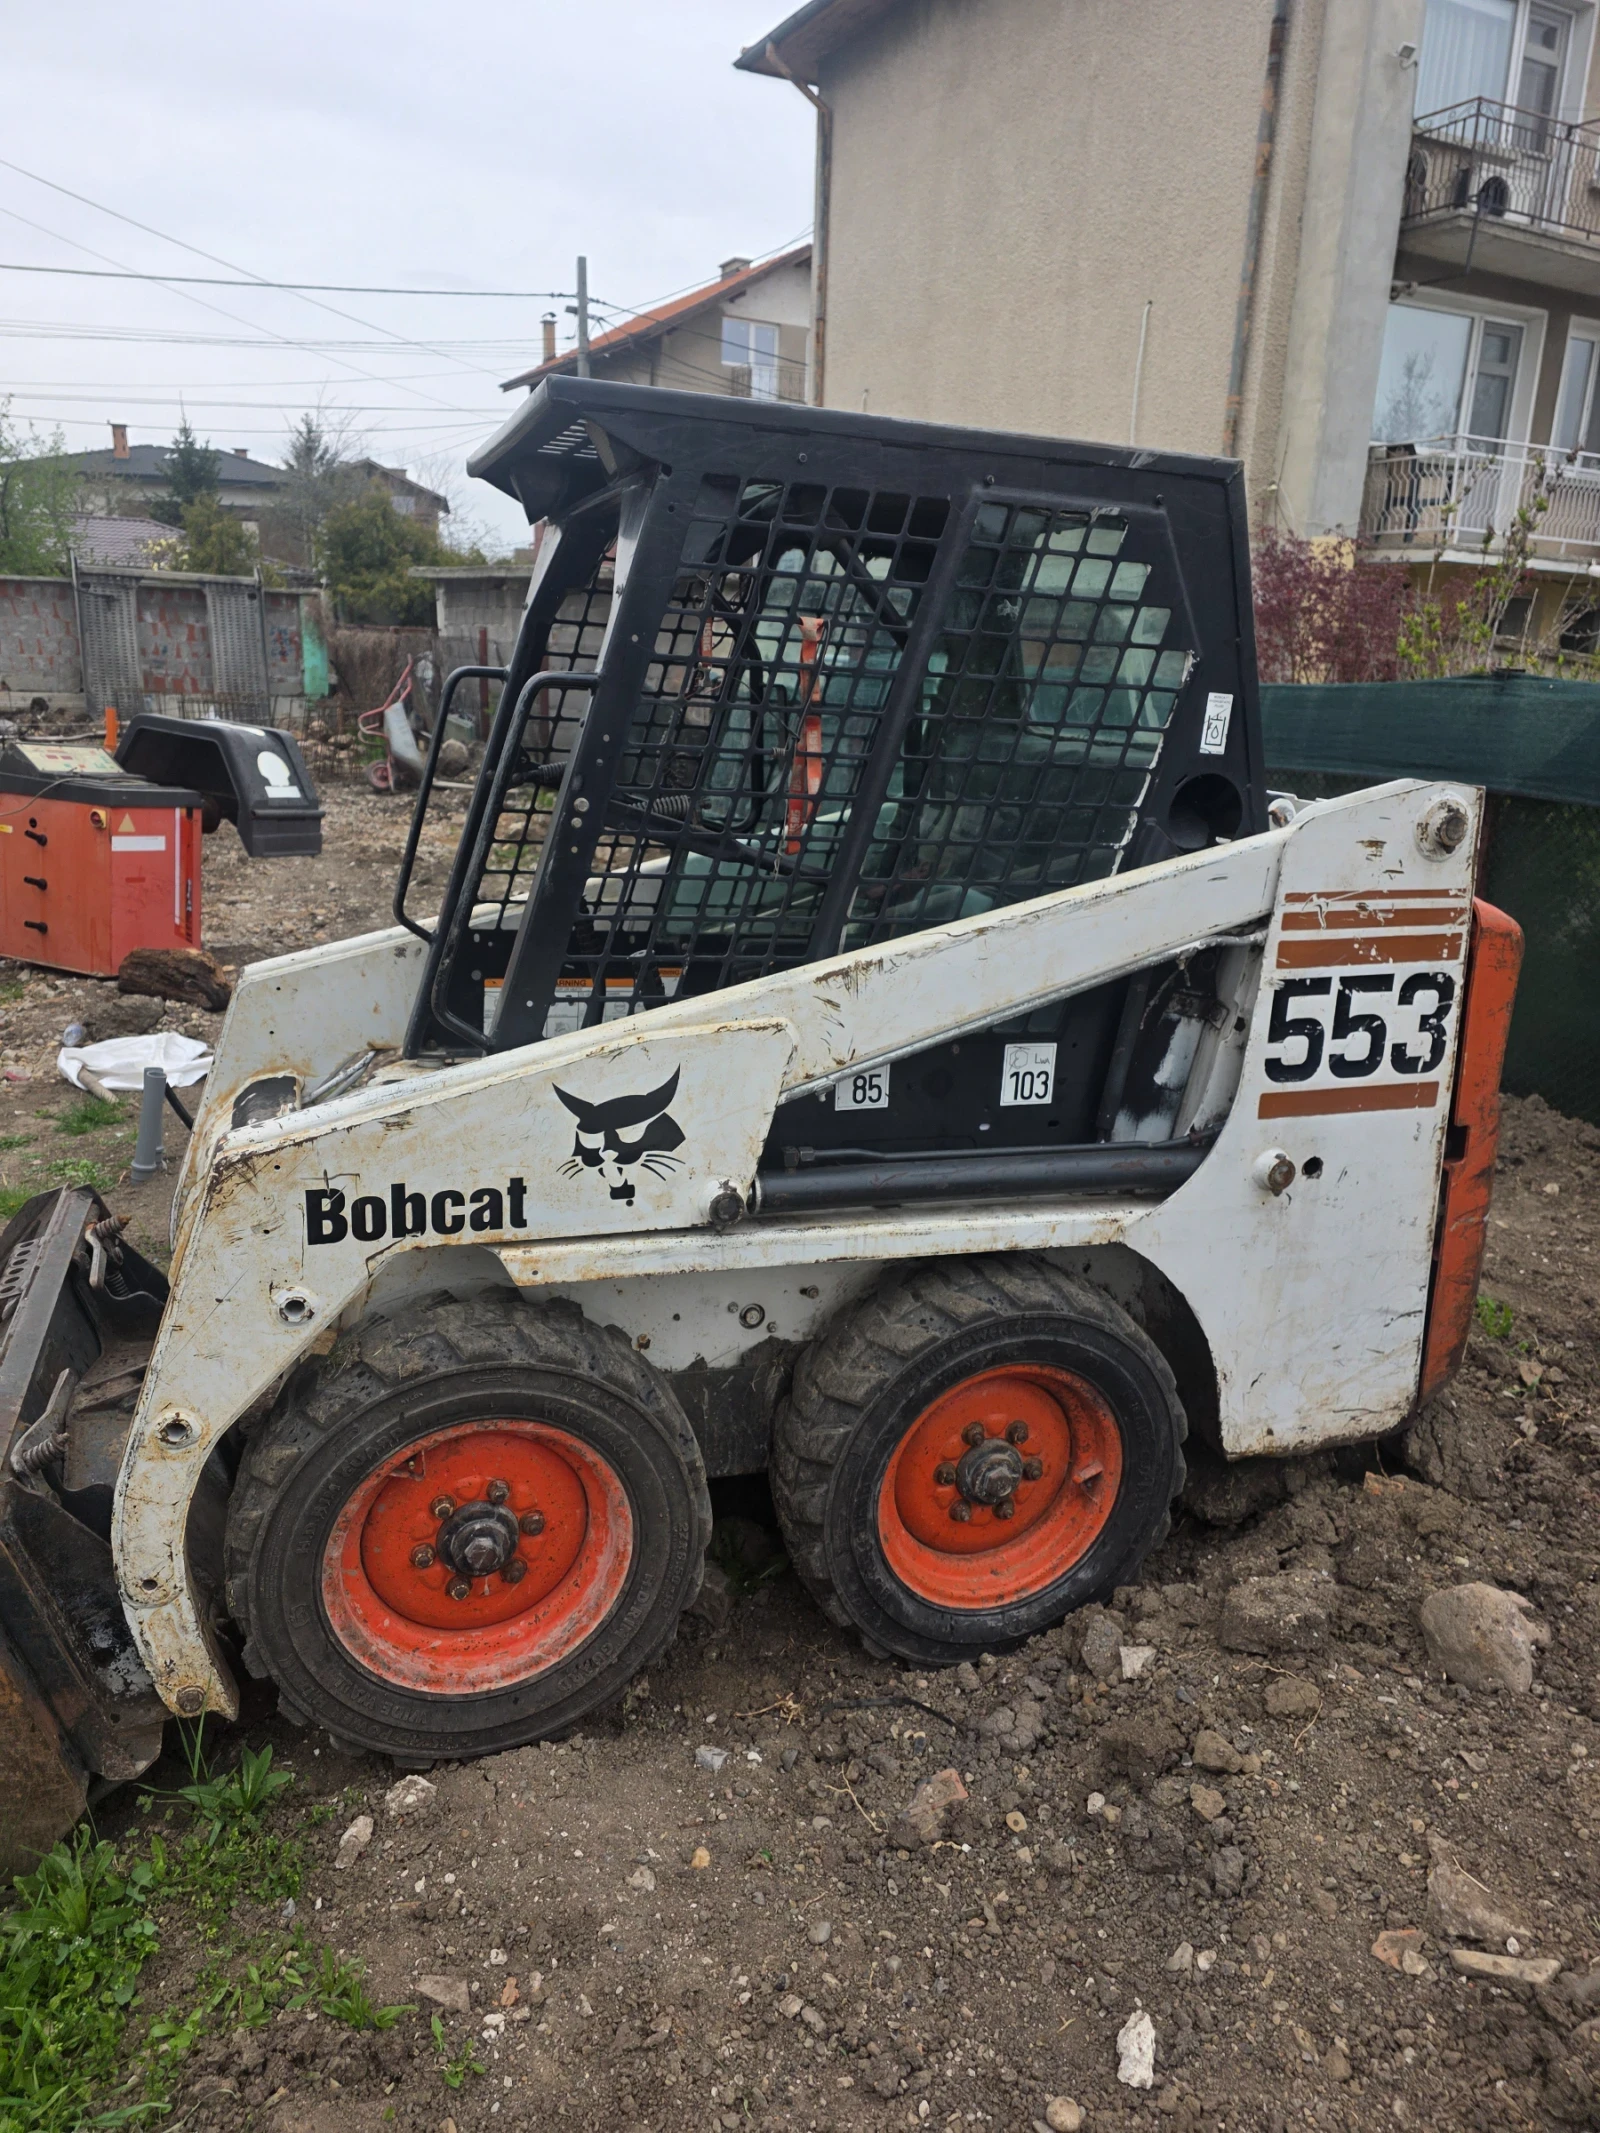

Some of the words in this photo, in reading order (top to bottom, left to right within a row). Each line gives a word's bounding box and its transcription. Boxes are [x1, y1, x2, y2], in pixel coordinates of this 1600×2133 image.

[1264, 971, 1455, 1083] 553
[852, 1074, 882, 1104] 85
[1009, 1070, 1049, 1101] 103
[305, 1177, 528, 1246] Bobcat
[333, 1674, 379, 1710] WALL
[378, 1700, 429, 1724] WIDE
